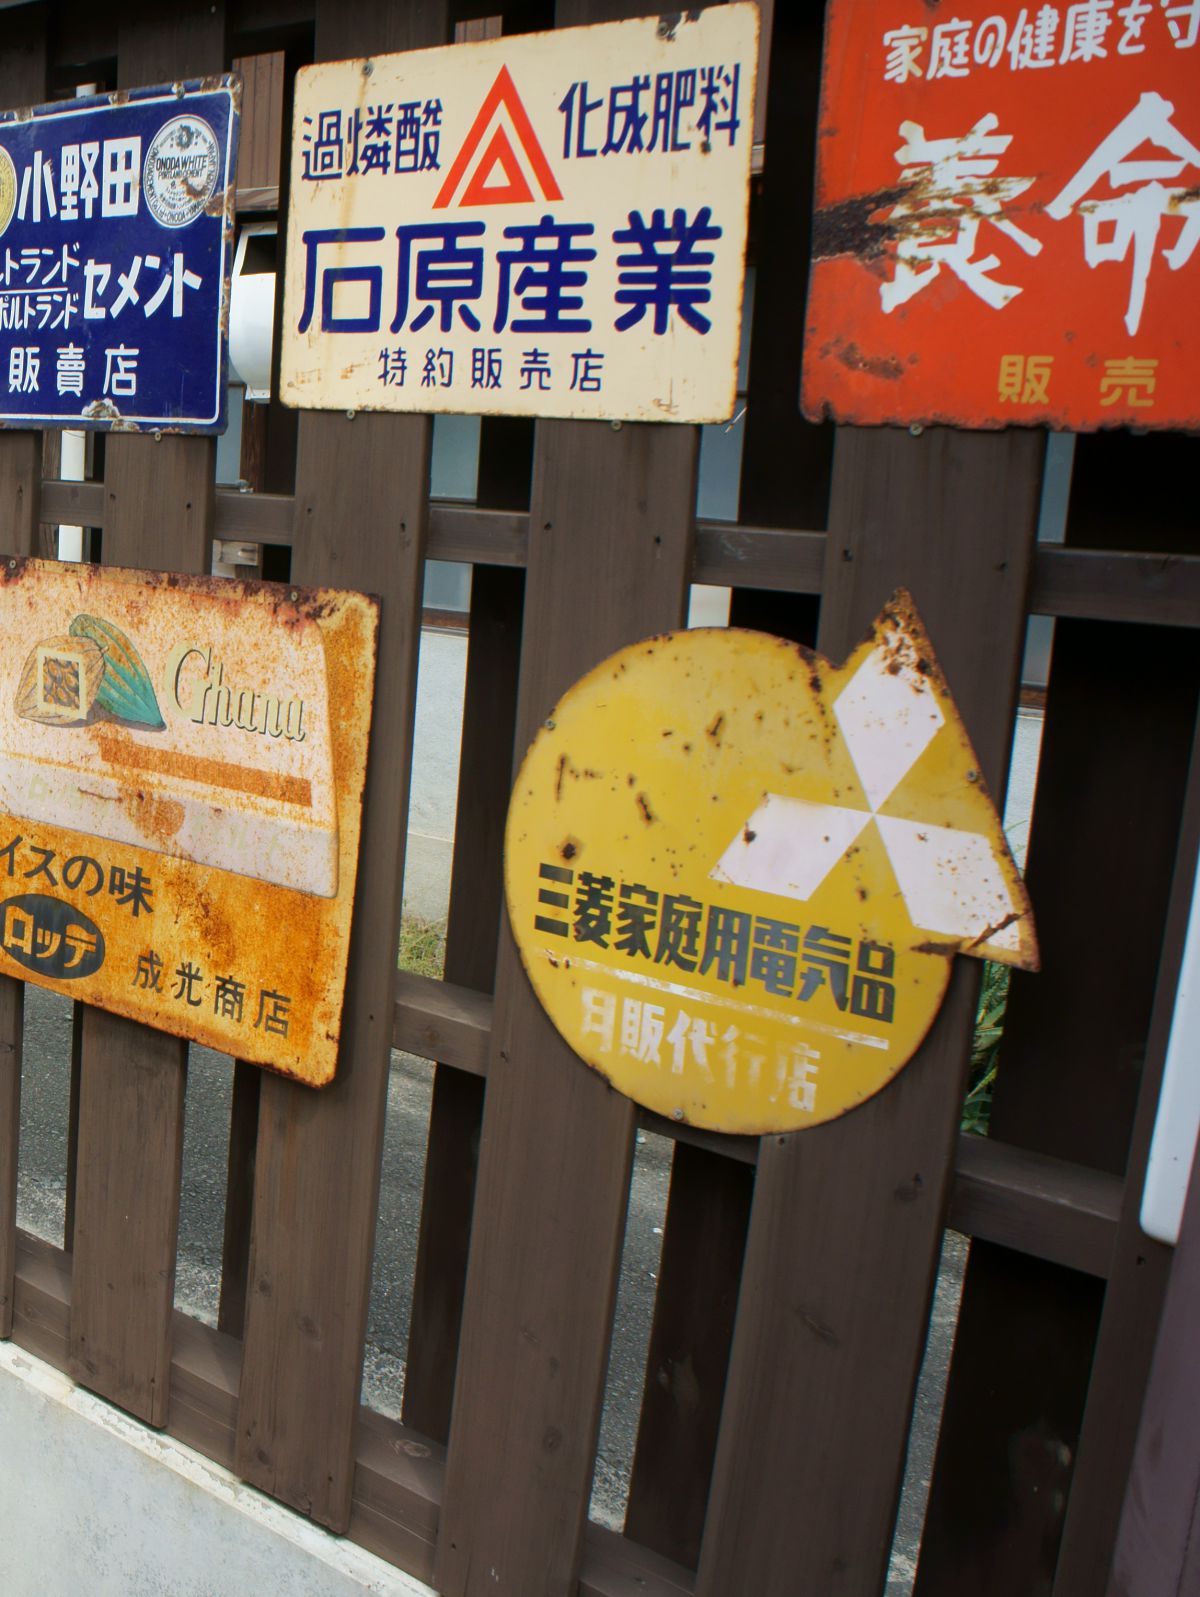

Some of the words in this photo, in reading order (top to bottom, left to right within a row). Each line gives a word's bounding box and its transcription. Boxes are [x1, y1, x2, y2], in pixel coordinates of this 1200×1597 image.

[156, 156, 180, 171] ONODA
[181, 154, 208, 169] WHITE
[301, 98, 443, 181] 過燐酸
[558, 62, 741, 160] 化成肥料
[17, 136, 142, 223] 小野田
[879, 91, 1200, 337] 養命
[83, 253, 202, 319] セメント
[297, 207, 723, 336] 石原産業
[8, 343, 140, 397] 販賣店
[377, 347, 606, 392] 特約販売店
[999, 355, 1159, 407] 販売
[166, 643, 307, 742] Ghana
[2, 905, 98, 969] ロッテ
[533, 862, 896, 1025] 三菱家庭用電気品
[131, 949, 293, 1040] 成光商店
